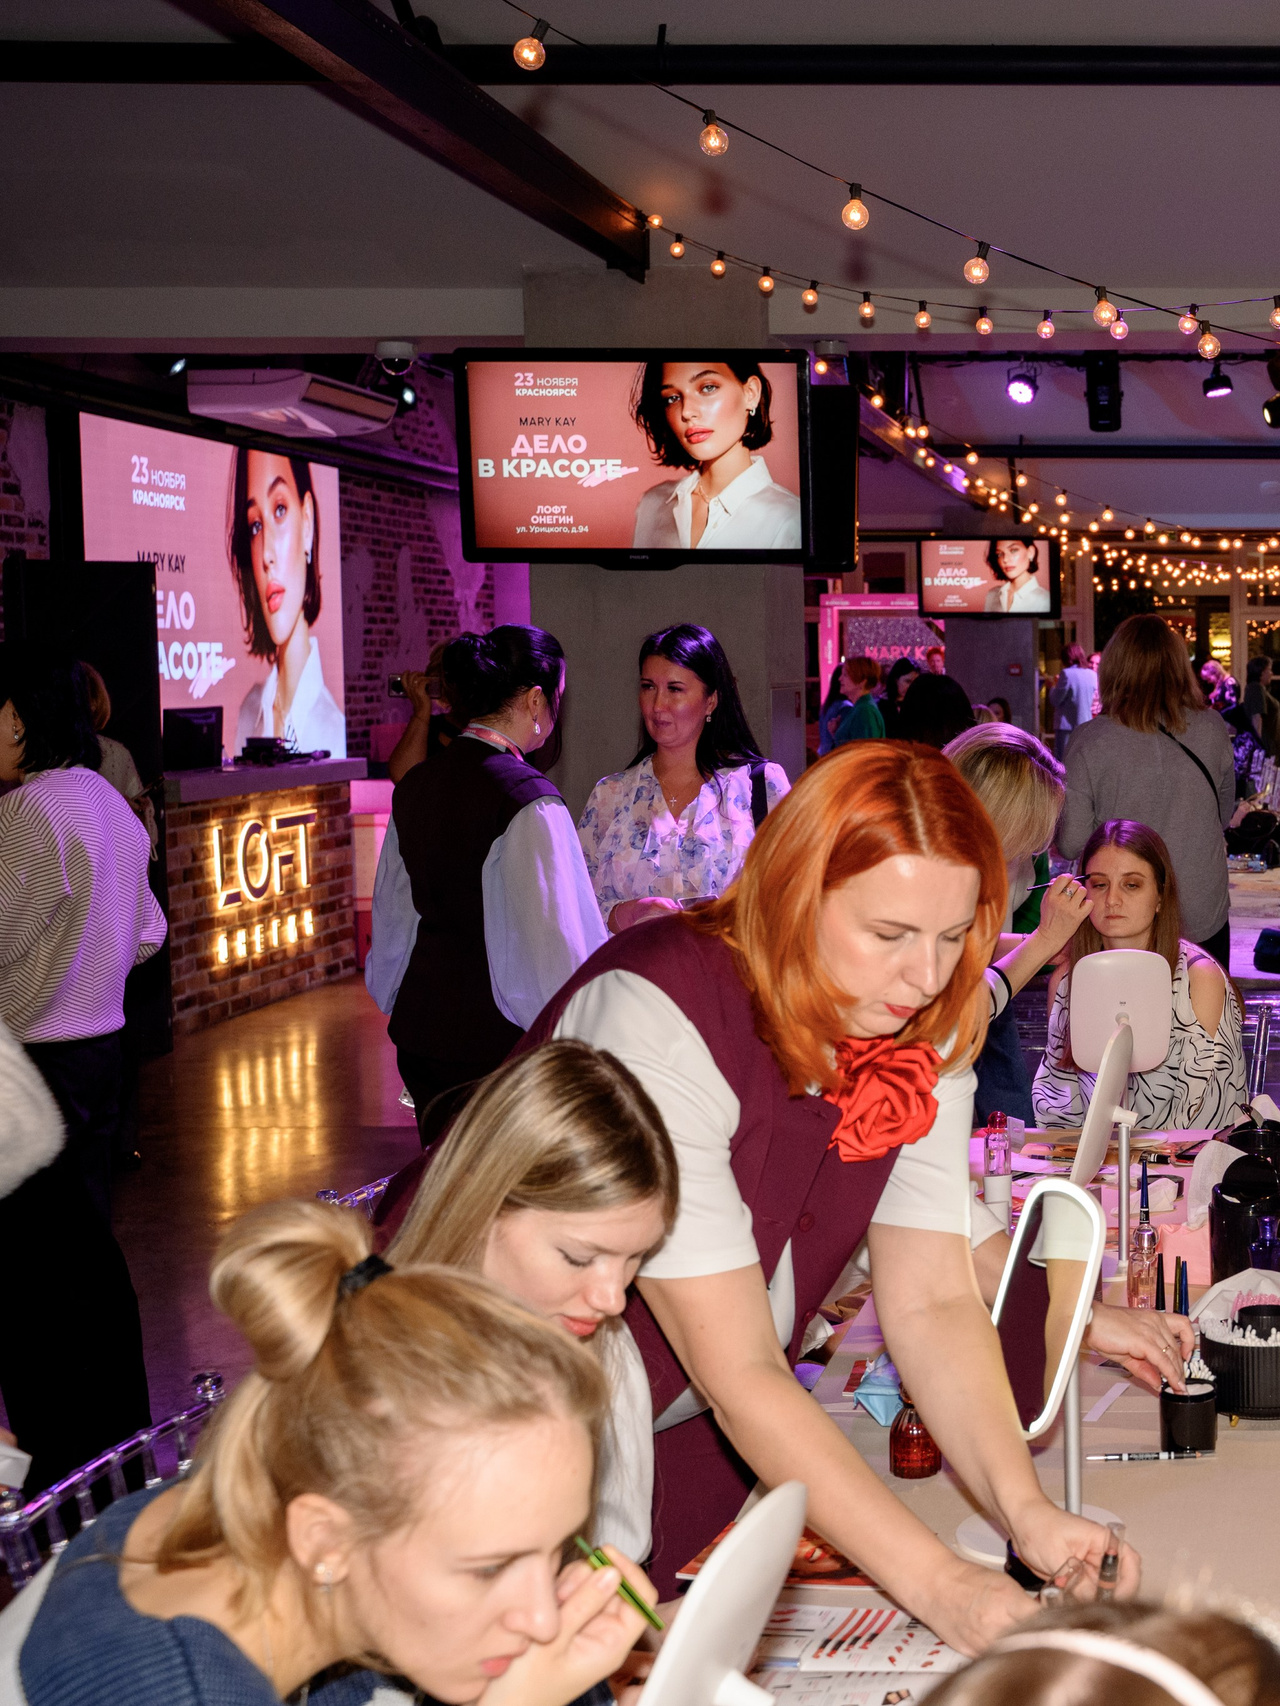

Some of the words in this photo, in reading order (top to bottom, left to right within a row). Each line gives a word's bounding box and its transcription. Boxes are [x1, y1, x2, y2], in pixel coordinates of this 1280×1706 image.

[514, 372, 534, 387] 23
[536, 377, 579, 387] НОЯБРЯ
[515, 388, 577, 397] КРАСНОЯРСК
[519, 416, 551, 427] MARY
[555, 416, 577, 427] KAY
[511, 434, 587, 458] ДЕЛО
[131, 454, 149, 485] 23
[150, 469, 186, 490] НОЯБРЯ
[477, 458, 496, 478] В
[502, 458, 623, 479] КРАСОТЕ
[132, 489, 186, 511] КРАСНОЯРСК
[536, 505, 567, 514] ЛОФТ
[530, 515, 574, 524] ОНЕГИН
[516, 526, 528, 534] ул.
[571, 525, 589, 534] д.94
[167, 553, 186, 573] KAY
[937, 567, 968, 578] ДЕЛО
